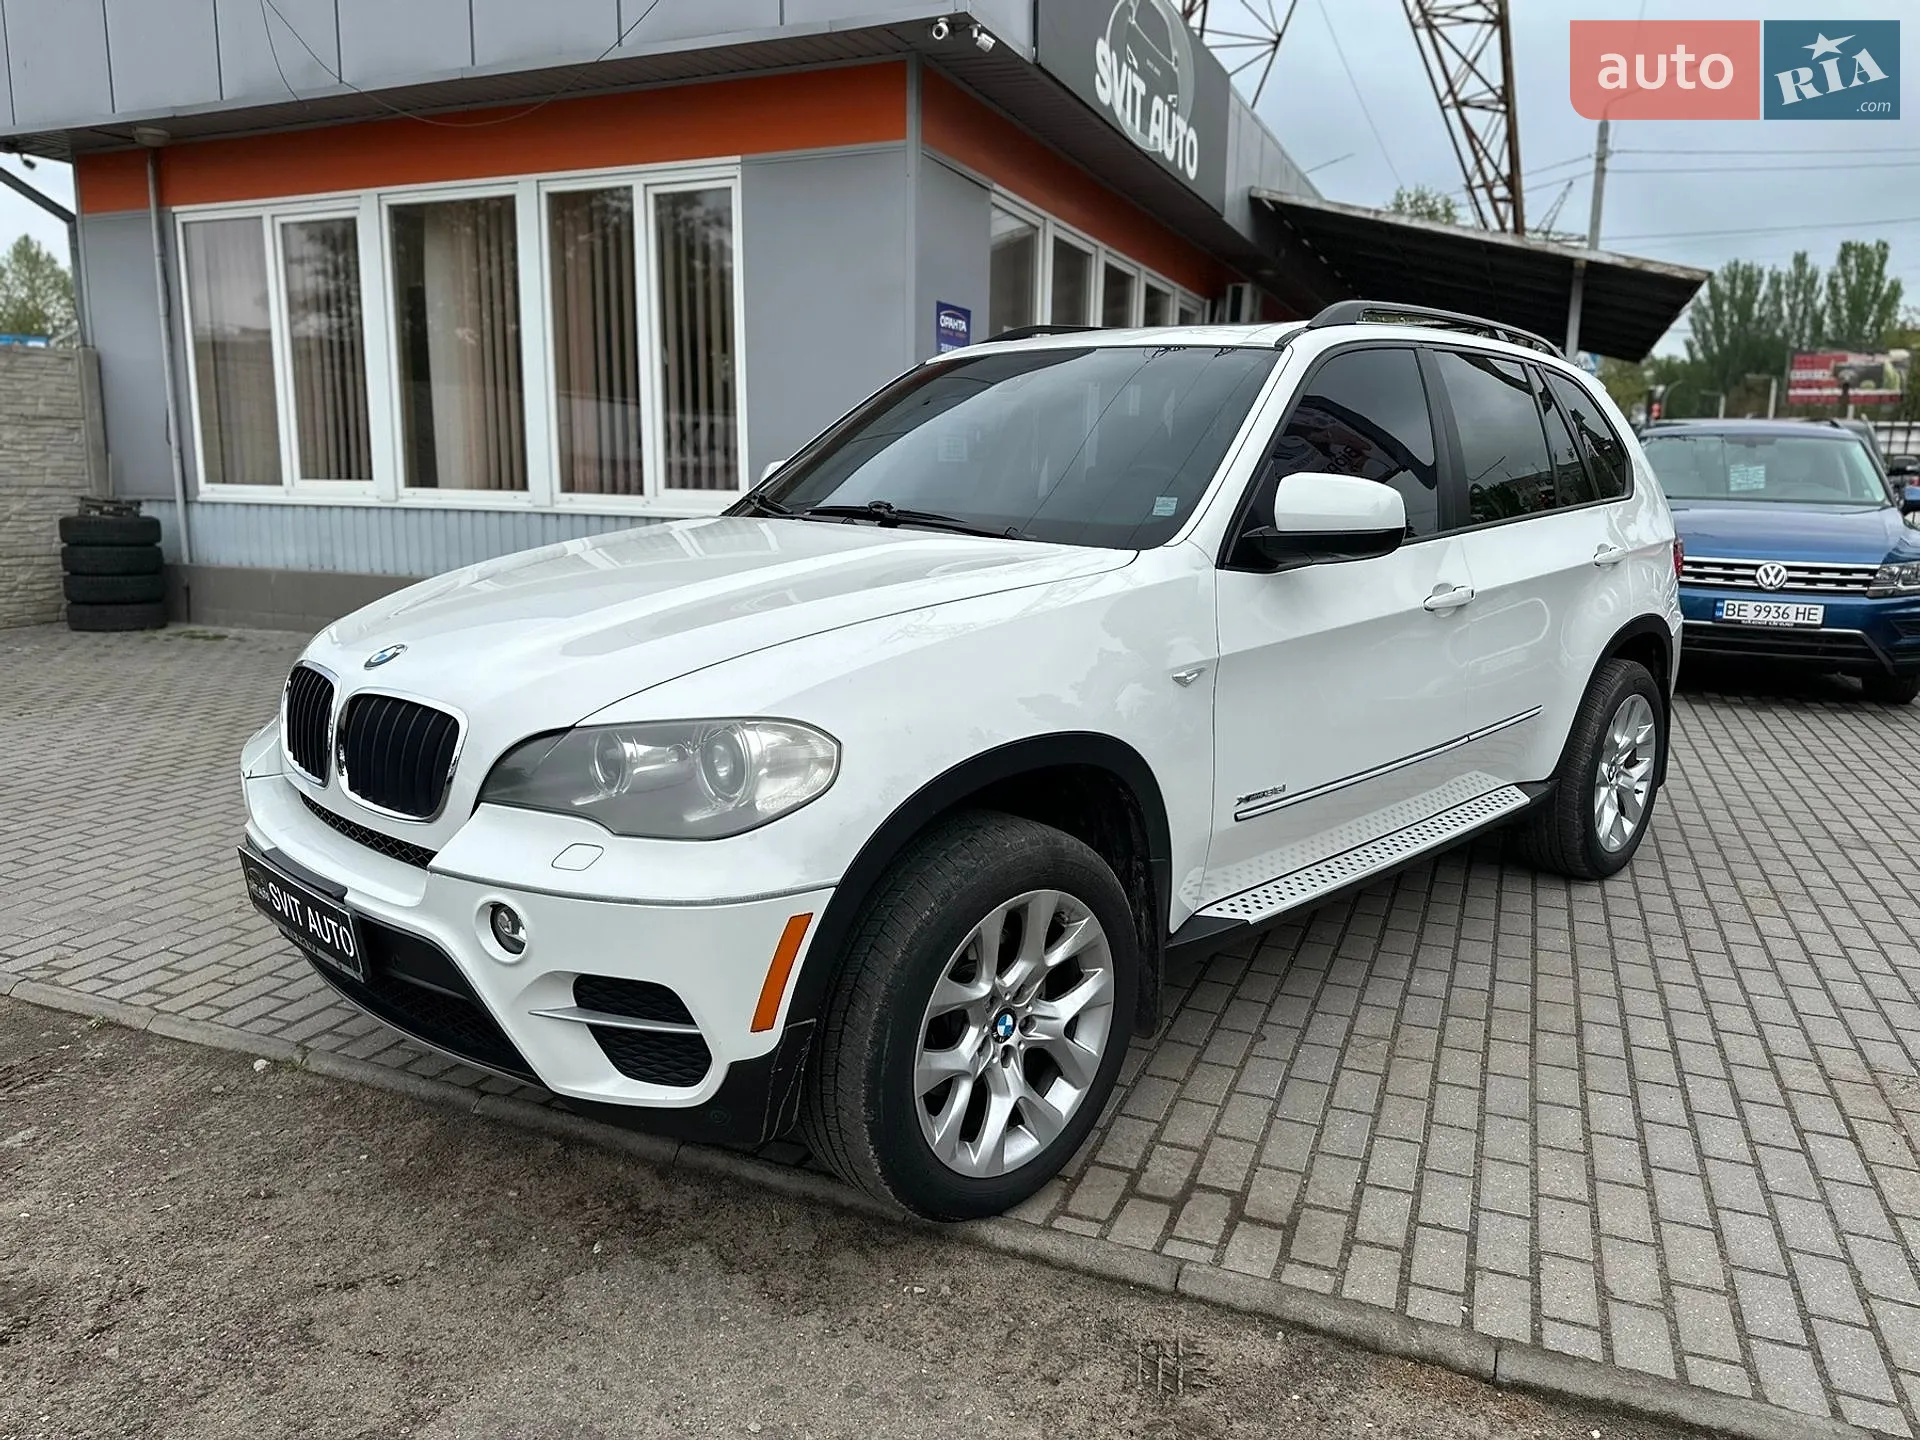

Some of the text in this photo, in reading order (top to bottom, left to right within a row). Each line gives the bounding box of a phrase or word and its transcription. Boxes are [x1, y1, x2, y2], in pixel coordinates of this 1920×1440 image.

[1095, 37, 1198, 180] SVIT AUTO
[1725, 603, 1819, 621] BE 9936 HE
[268, 881, 303, 926] SVIT
[307, 906, 355, 958] AUTO
